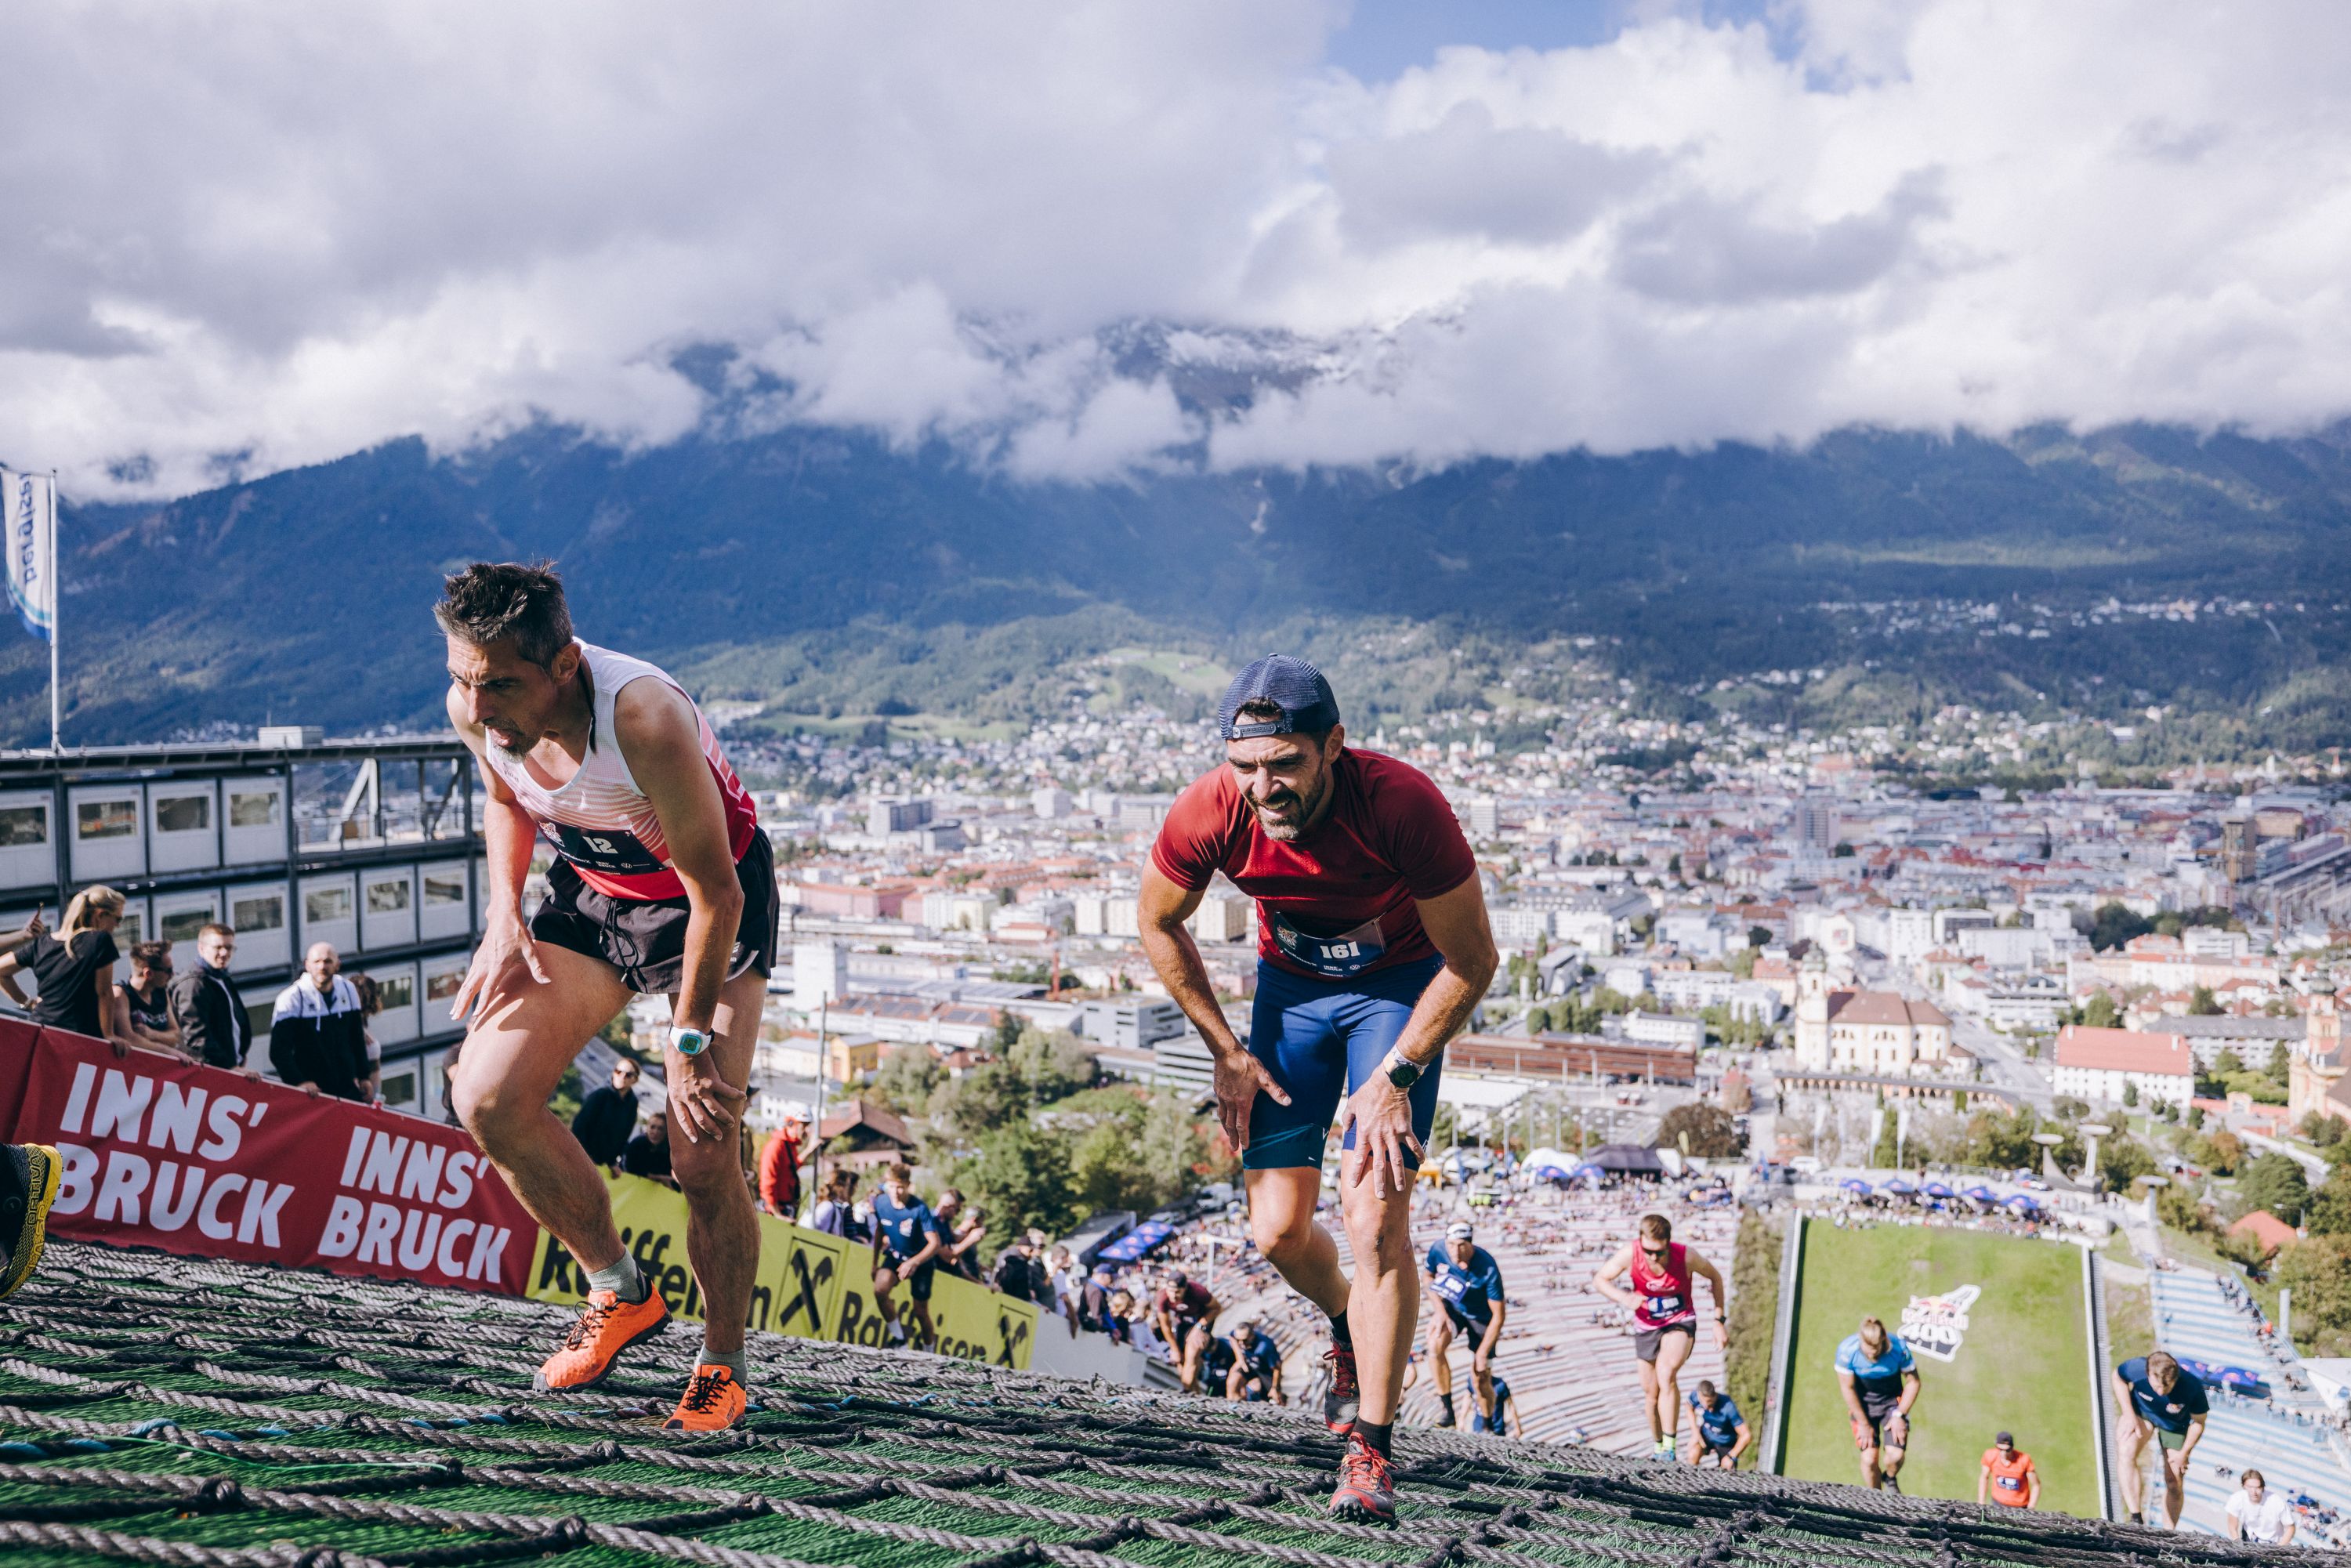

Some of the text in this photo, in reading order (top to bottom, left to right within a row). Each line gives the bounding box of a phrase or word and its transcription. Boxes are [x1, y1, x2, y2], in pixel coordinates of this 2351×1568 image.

[582, 836, 618, 854] 12
[1319, 941, 1360, 958] 161
[60, 1062, 268, 1162] INNS'
[49, 1142, 295, 1249] BRUCK
[339, 1125, 489, 1210] INNS'
[317, 1195, 512, 1284] BRUCK
[1901, 1323, 1958, 1345] 400
